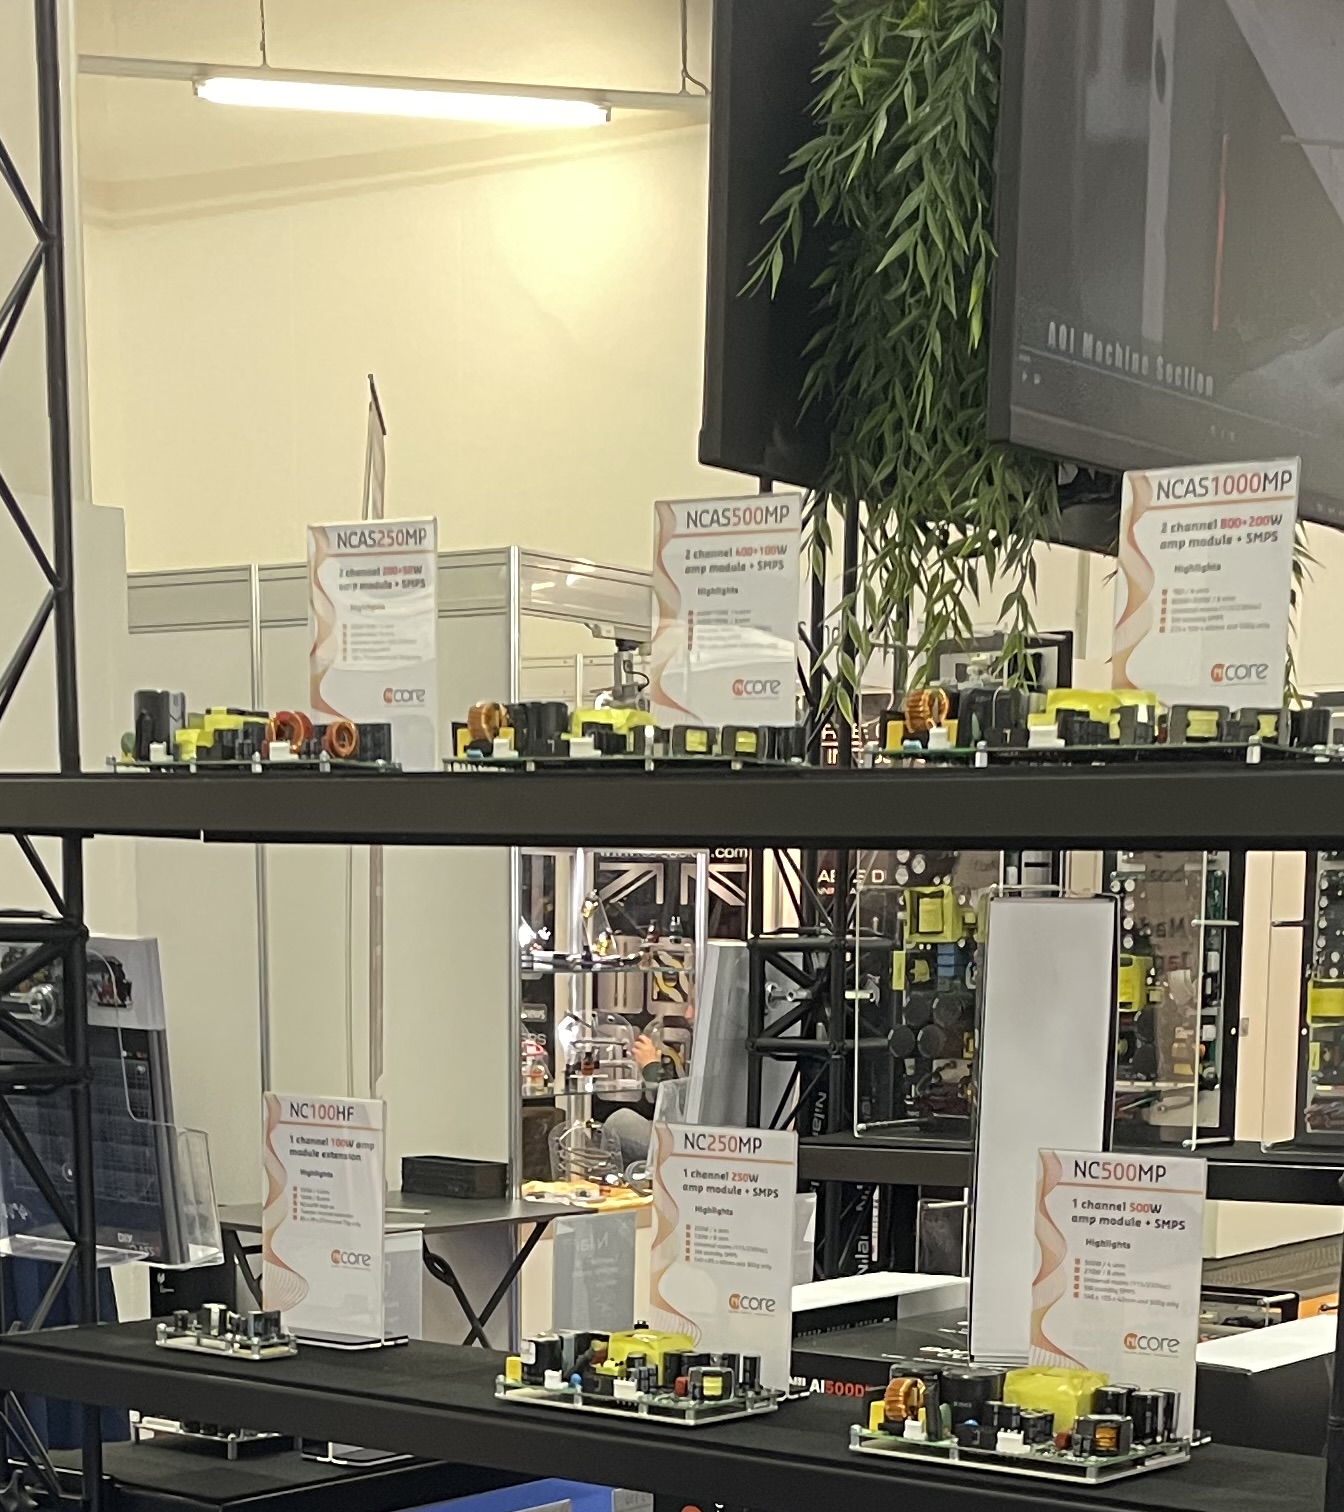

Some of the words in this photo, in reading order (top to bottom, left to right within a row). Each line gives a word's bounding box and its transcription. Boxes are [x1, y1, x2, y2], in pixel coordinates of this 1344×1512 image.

[1156, 470, 1293, 501] NCAS1000MP
[686, 504, 790, 529] NCAS500MP
[337, 527, 427, 549] NCAS250MP
[1160, 539, 1185, 550] amp
[1189, 534, 1232, 548] module
[1246, 530, 1278, 544] SMPS
[290, 1101, 355, 1122] NC100HF
[683, 1132, 762, 1155] NC250MP
[690, 1169, 729, 1181] channel
[731, 1172, 759, 1184] 250W
[1073, 1159, 1167, 1183] NC500MP
[682, 1183, 704, 1194] amp
[706, 1184, 742, 1197] module
[752, 1187, 779, 1199] SMPS
[1081, 1199, 1127, 1213] channel
[1129, 1202, 1163, 1214] 500W
[1071, 1214, 1096, 1226] amp
[1099, 1215, 1142, 1229] module
[1154, 1218, 1186, 1231] SMPS
[1085, 1237, 1131, 1250] Highlights
